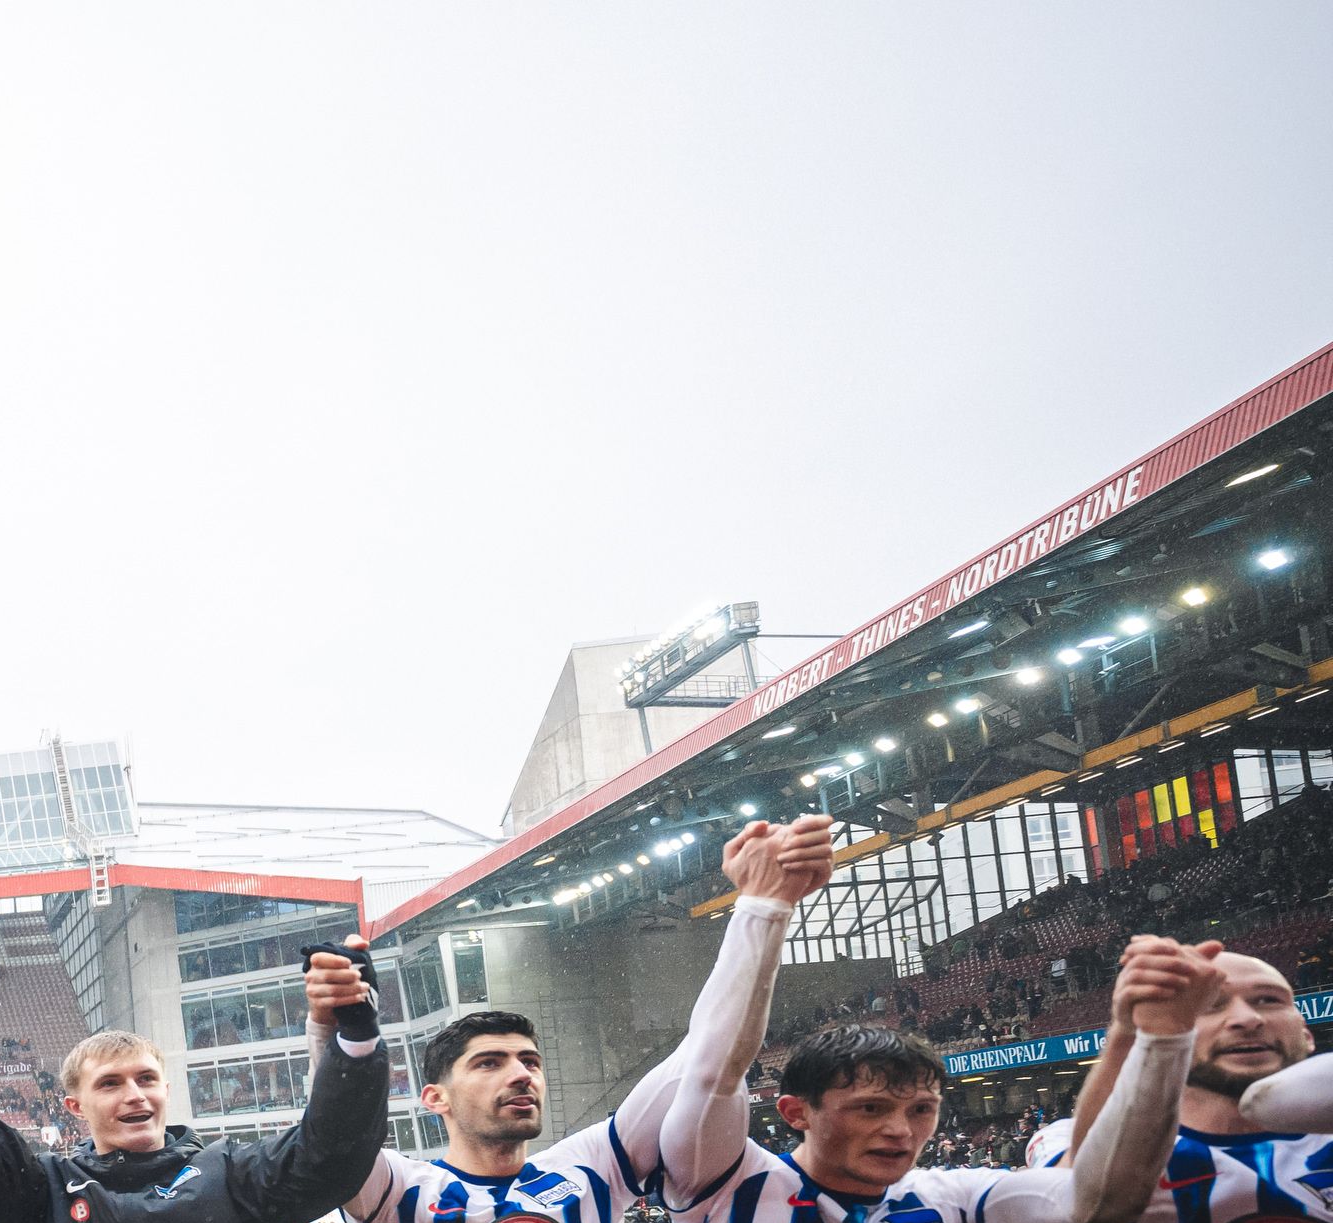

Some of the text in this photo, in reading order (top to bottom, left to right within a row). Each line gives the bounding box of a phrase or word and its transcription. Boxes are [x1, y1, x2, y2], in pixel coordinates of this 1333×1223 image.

[751, 650, 834, 720] NORBERT
[850, 594, 927, 662] THINES
[945, 465, 1144, 608] NORDTRIBÜNE
[949, 1056, 969, 1074] DIE
[971, 1042, 1047, 1071] RHEINPFALZ
[1064, 1037, 1090, 1055] Wir
[75, 1202, 87, 1218] B
